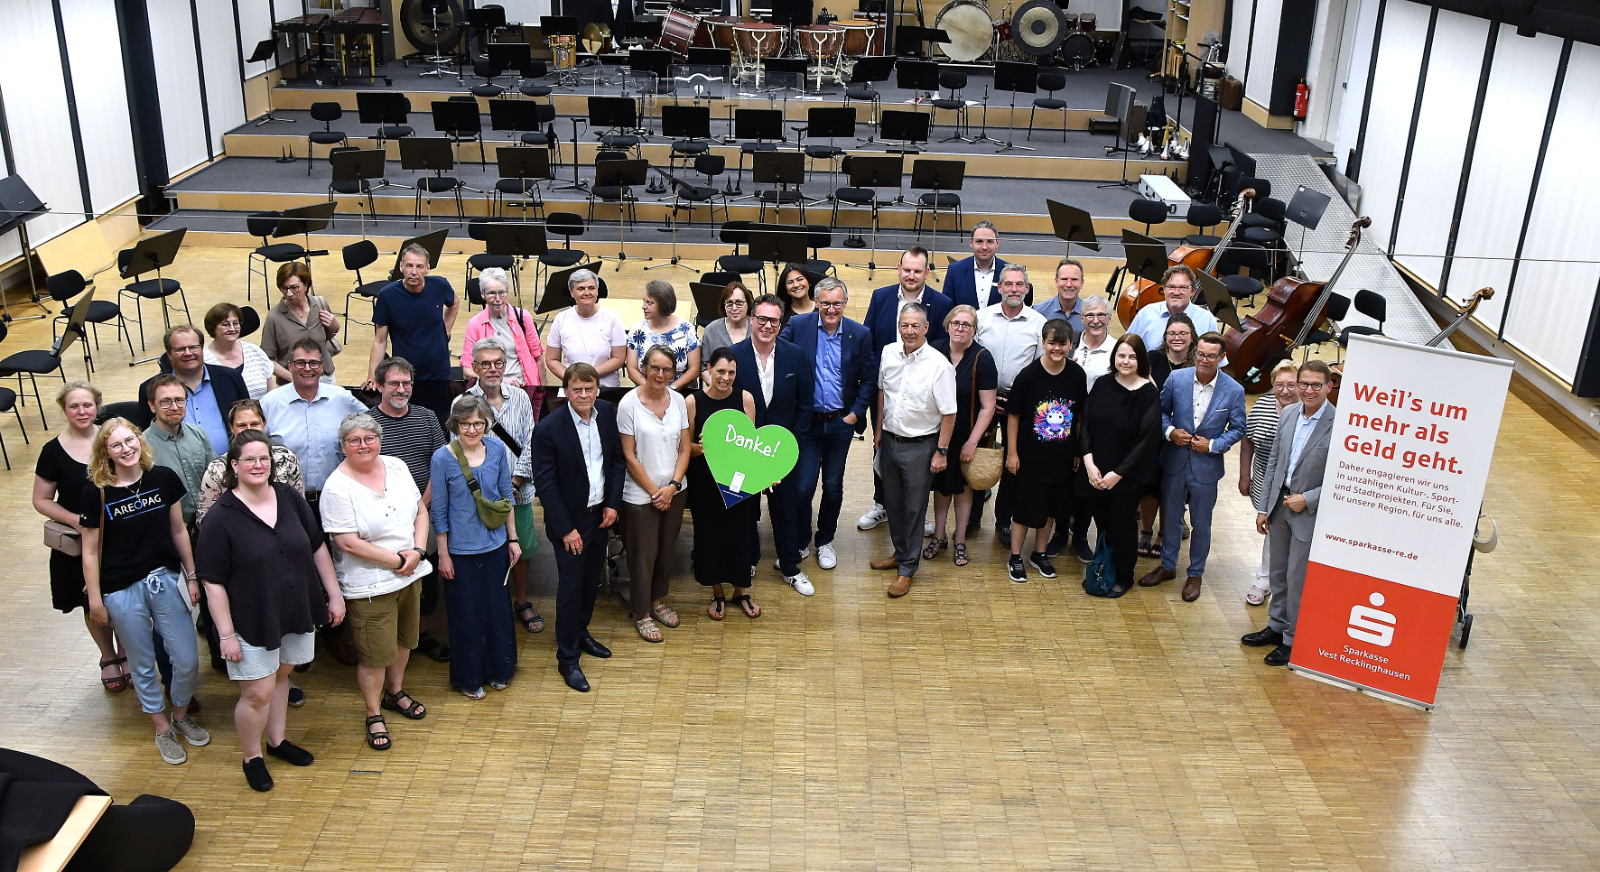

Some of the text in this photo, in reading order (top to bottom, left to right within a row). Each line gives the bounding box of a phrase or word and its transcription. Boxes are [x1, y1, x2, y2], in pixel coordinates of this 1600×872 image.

[1354, 382, 1468, 421] Weil’s um
[725, 424, 780, 457] Danke!
[1348, 412, 1449, 444] mehr als
[1343, 434, 1463, 475] Geld geht.
[1336, 471, 1347, 480] in
[1347, 474, 1394, 491] unzähligen
[1431, 492, 1459, 505] Sport-
[1338, 460, 1449, 491] Daher engagieren wir uns
[1332, 492, 1345, 501] für
[1346, 496, 1376, 508] unsere
[1412, 510, 1425, 520] für
[1426, 514, 1443, 524] uns
[1334, 483, 1454, 516] und Stadtprojekten. Für Sie,
[1325, 533, 1419, 561] www.sparkasse-re.de
[1318, 648, 1411, 681] Vest Recklinghausen
[1342, 644, 1389, 664] Sparkasse
